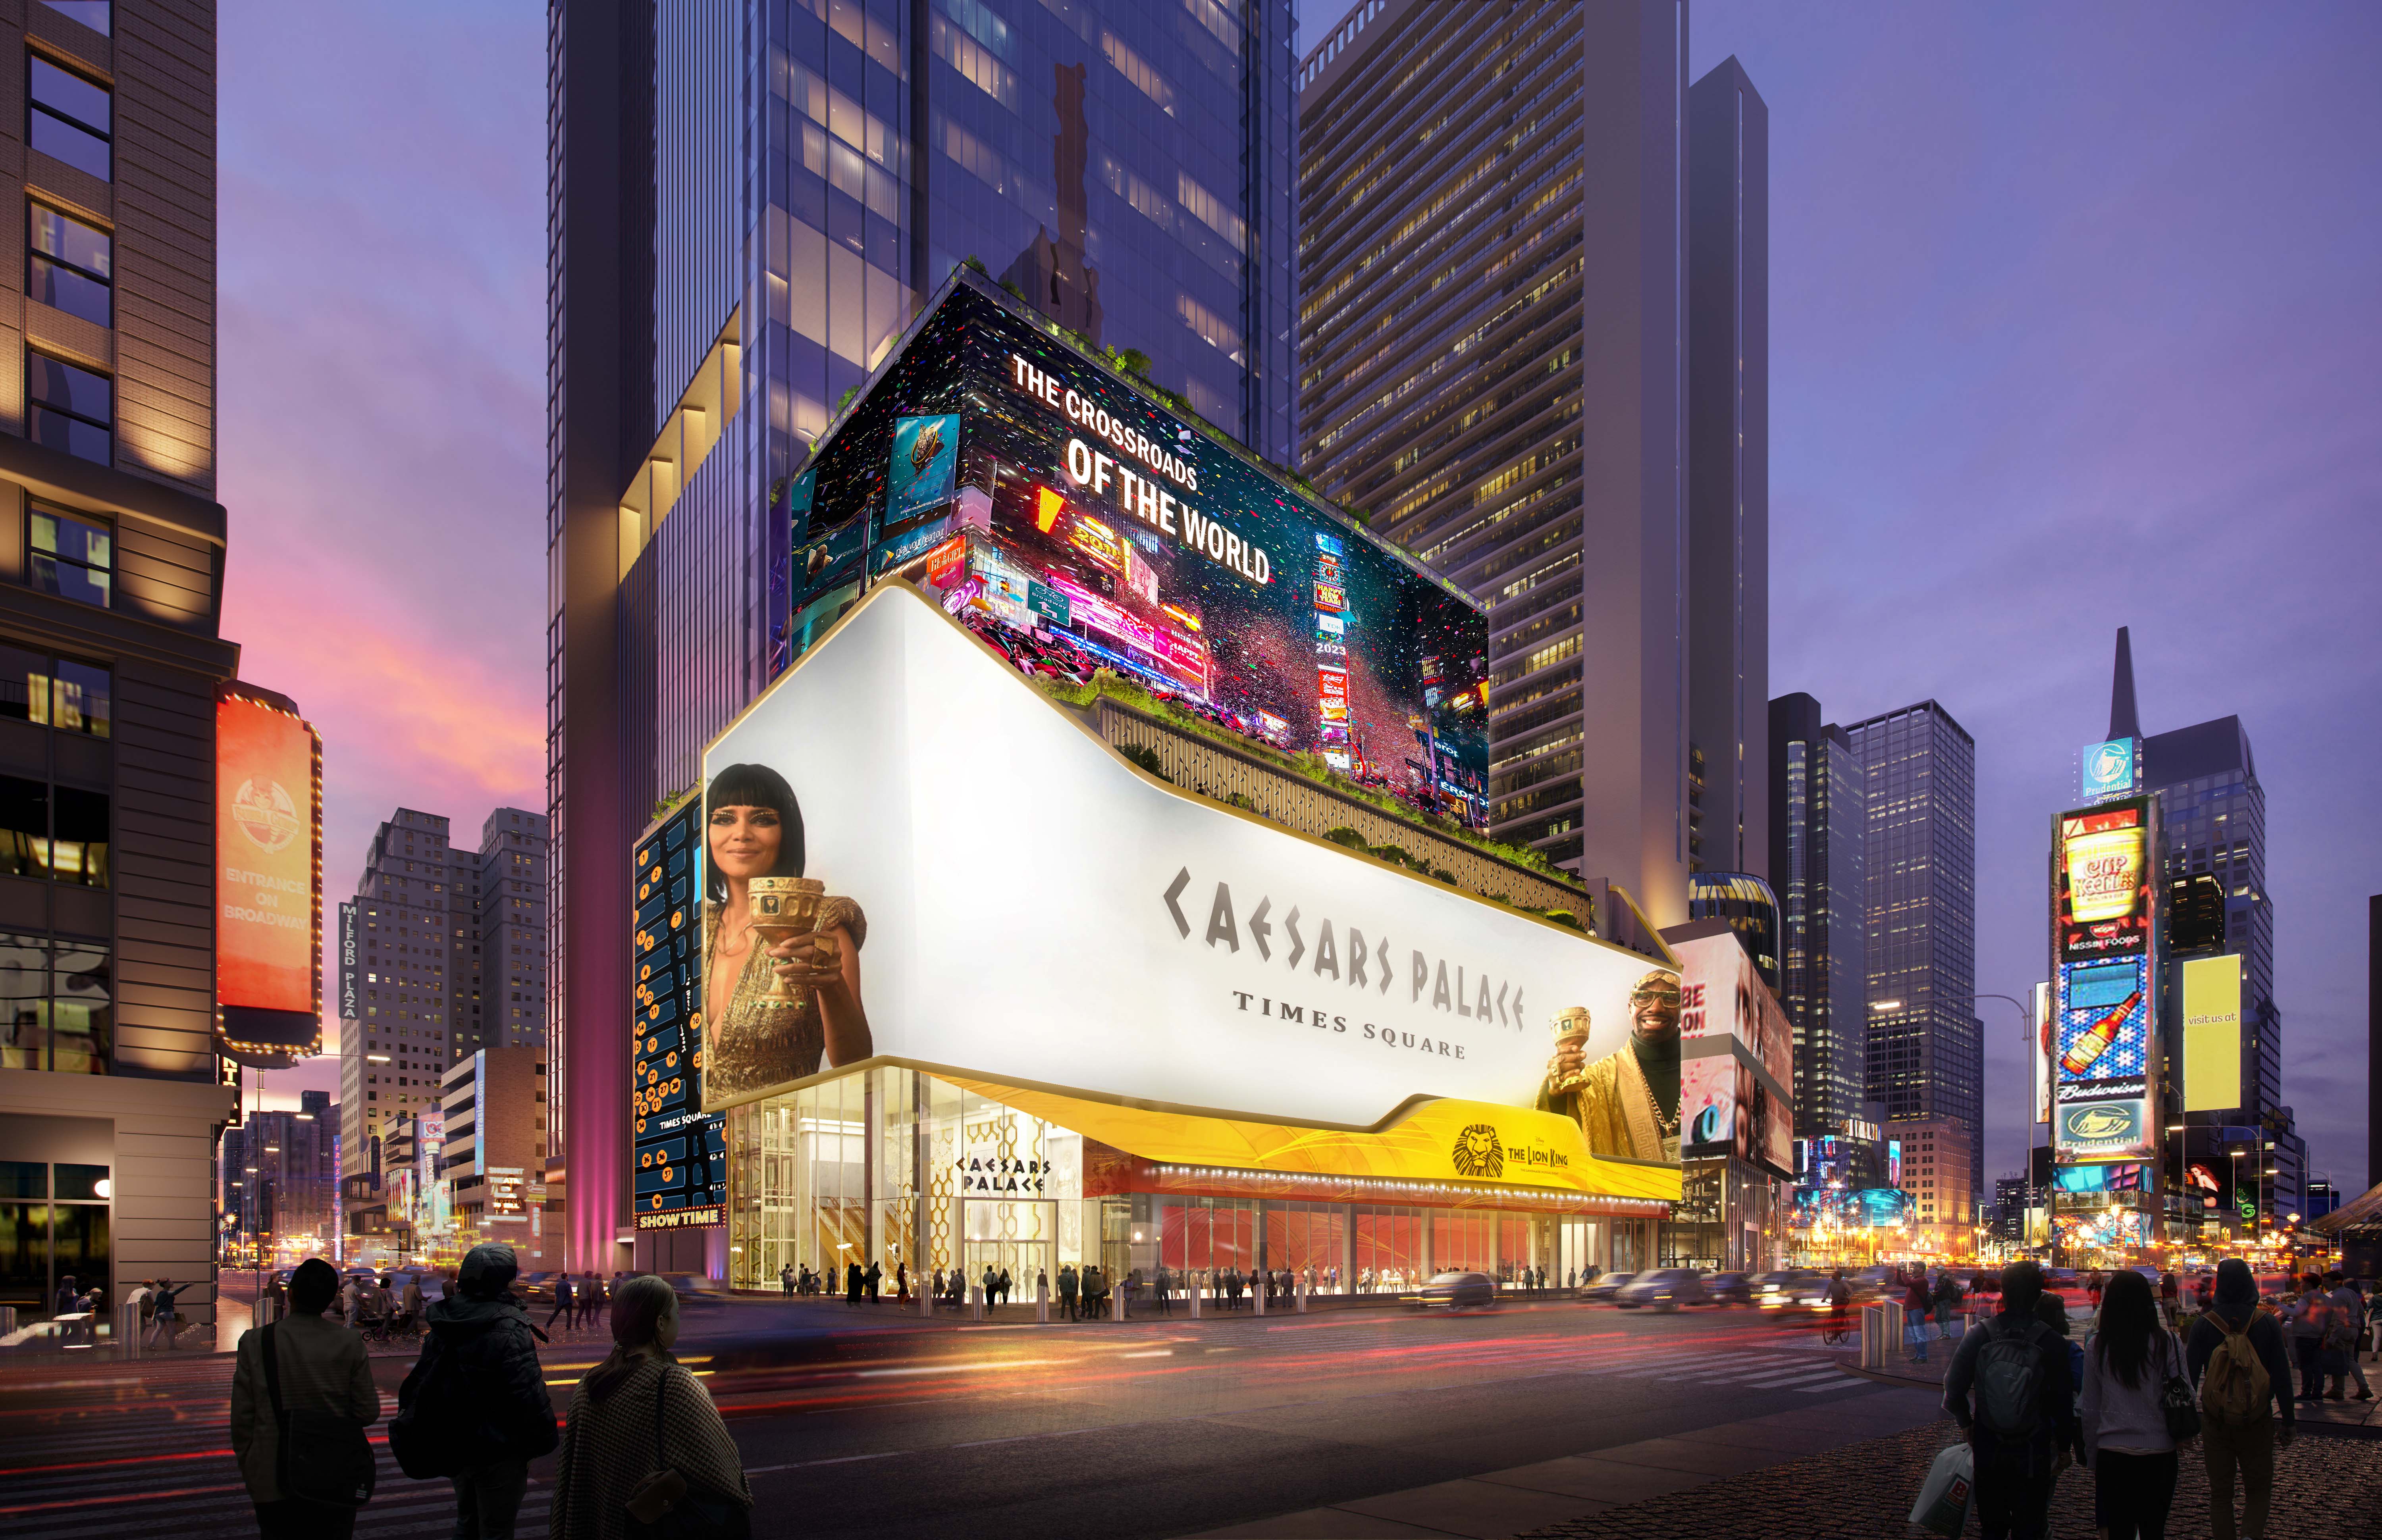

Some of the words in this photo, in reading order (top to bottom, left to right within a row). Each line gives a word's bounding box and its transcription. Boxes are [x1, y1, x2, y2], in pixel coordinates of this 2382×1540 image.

[1013, 353, 1060, 408] THE
[1066, 388, 1197, 491] CROSSROADS
[1068, 438, 1112, 495] OF
[1119, 466, 1176, 535] THE
[1182, 504, 1269, 584] WORLD
[896, 545, 909, 557] play
[909, 538, 922, 549] your
[922, 532, 936, 544] heart
[931, 557, 941, 572] HE
[948, 547, 962, 563] GIFT
[1317, 584, 1342, 595] HAPPY
[1322, 591, 1339, 599] NEW
[1032, 593, 1066, 610] Broadway
[1316, 643, 1346, 655] 2023
[2086, 779, 2130, 796] Prudential
[226, 868, 305, 895] ENTRANCE
[256, 893, 278, 908] ON
[225, 905, 307, 930] BROADWAY
[343, 905, 357, 965] MILFORD
[2069, 941, 2104, 951] NISSIN
[2105, 935, 2140, 946] FOODS
[1163, 865, 1393, 996] CAESARS
[1412, 949, 1523, 1033] PALACE
[344, 972, 355, 1018] PLAZA
[1233, 991, 1346, 1032] TIMES
[1364, 1023, 1466, 1060] SQUARE
[2189, 1015, 2209, 1024] visit
[2225, 1013, 2236, 1021] at
[2058, 1082, 2146, 1100] Budweiser
[659, 1119, 680, 1130] TIMES
[2062, 1136, 2137, 1148] Prudential
[956, 1157, 1051, 1174] CAESARS
[1508, 1148, 1525, 1160] THE
[1528, 1146, 1548, 1165] LION
[1550, 1149, 1568, 1167] KING
[964, 1176, 1043, 1192] PALACE
[640, 1213, 680, 1228] SHOW
[681, 1210, 718, 1224] TIME
